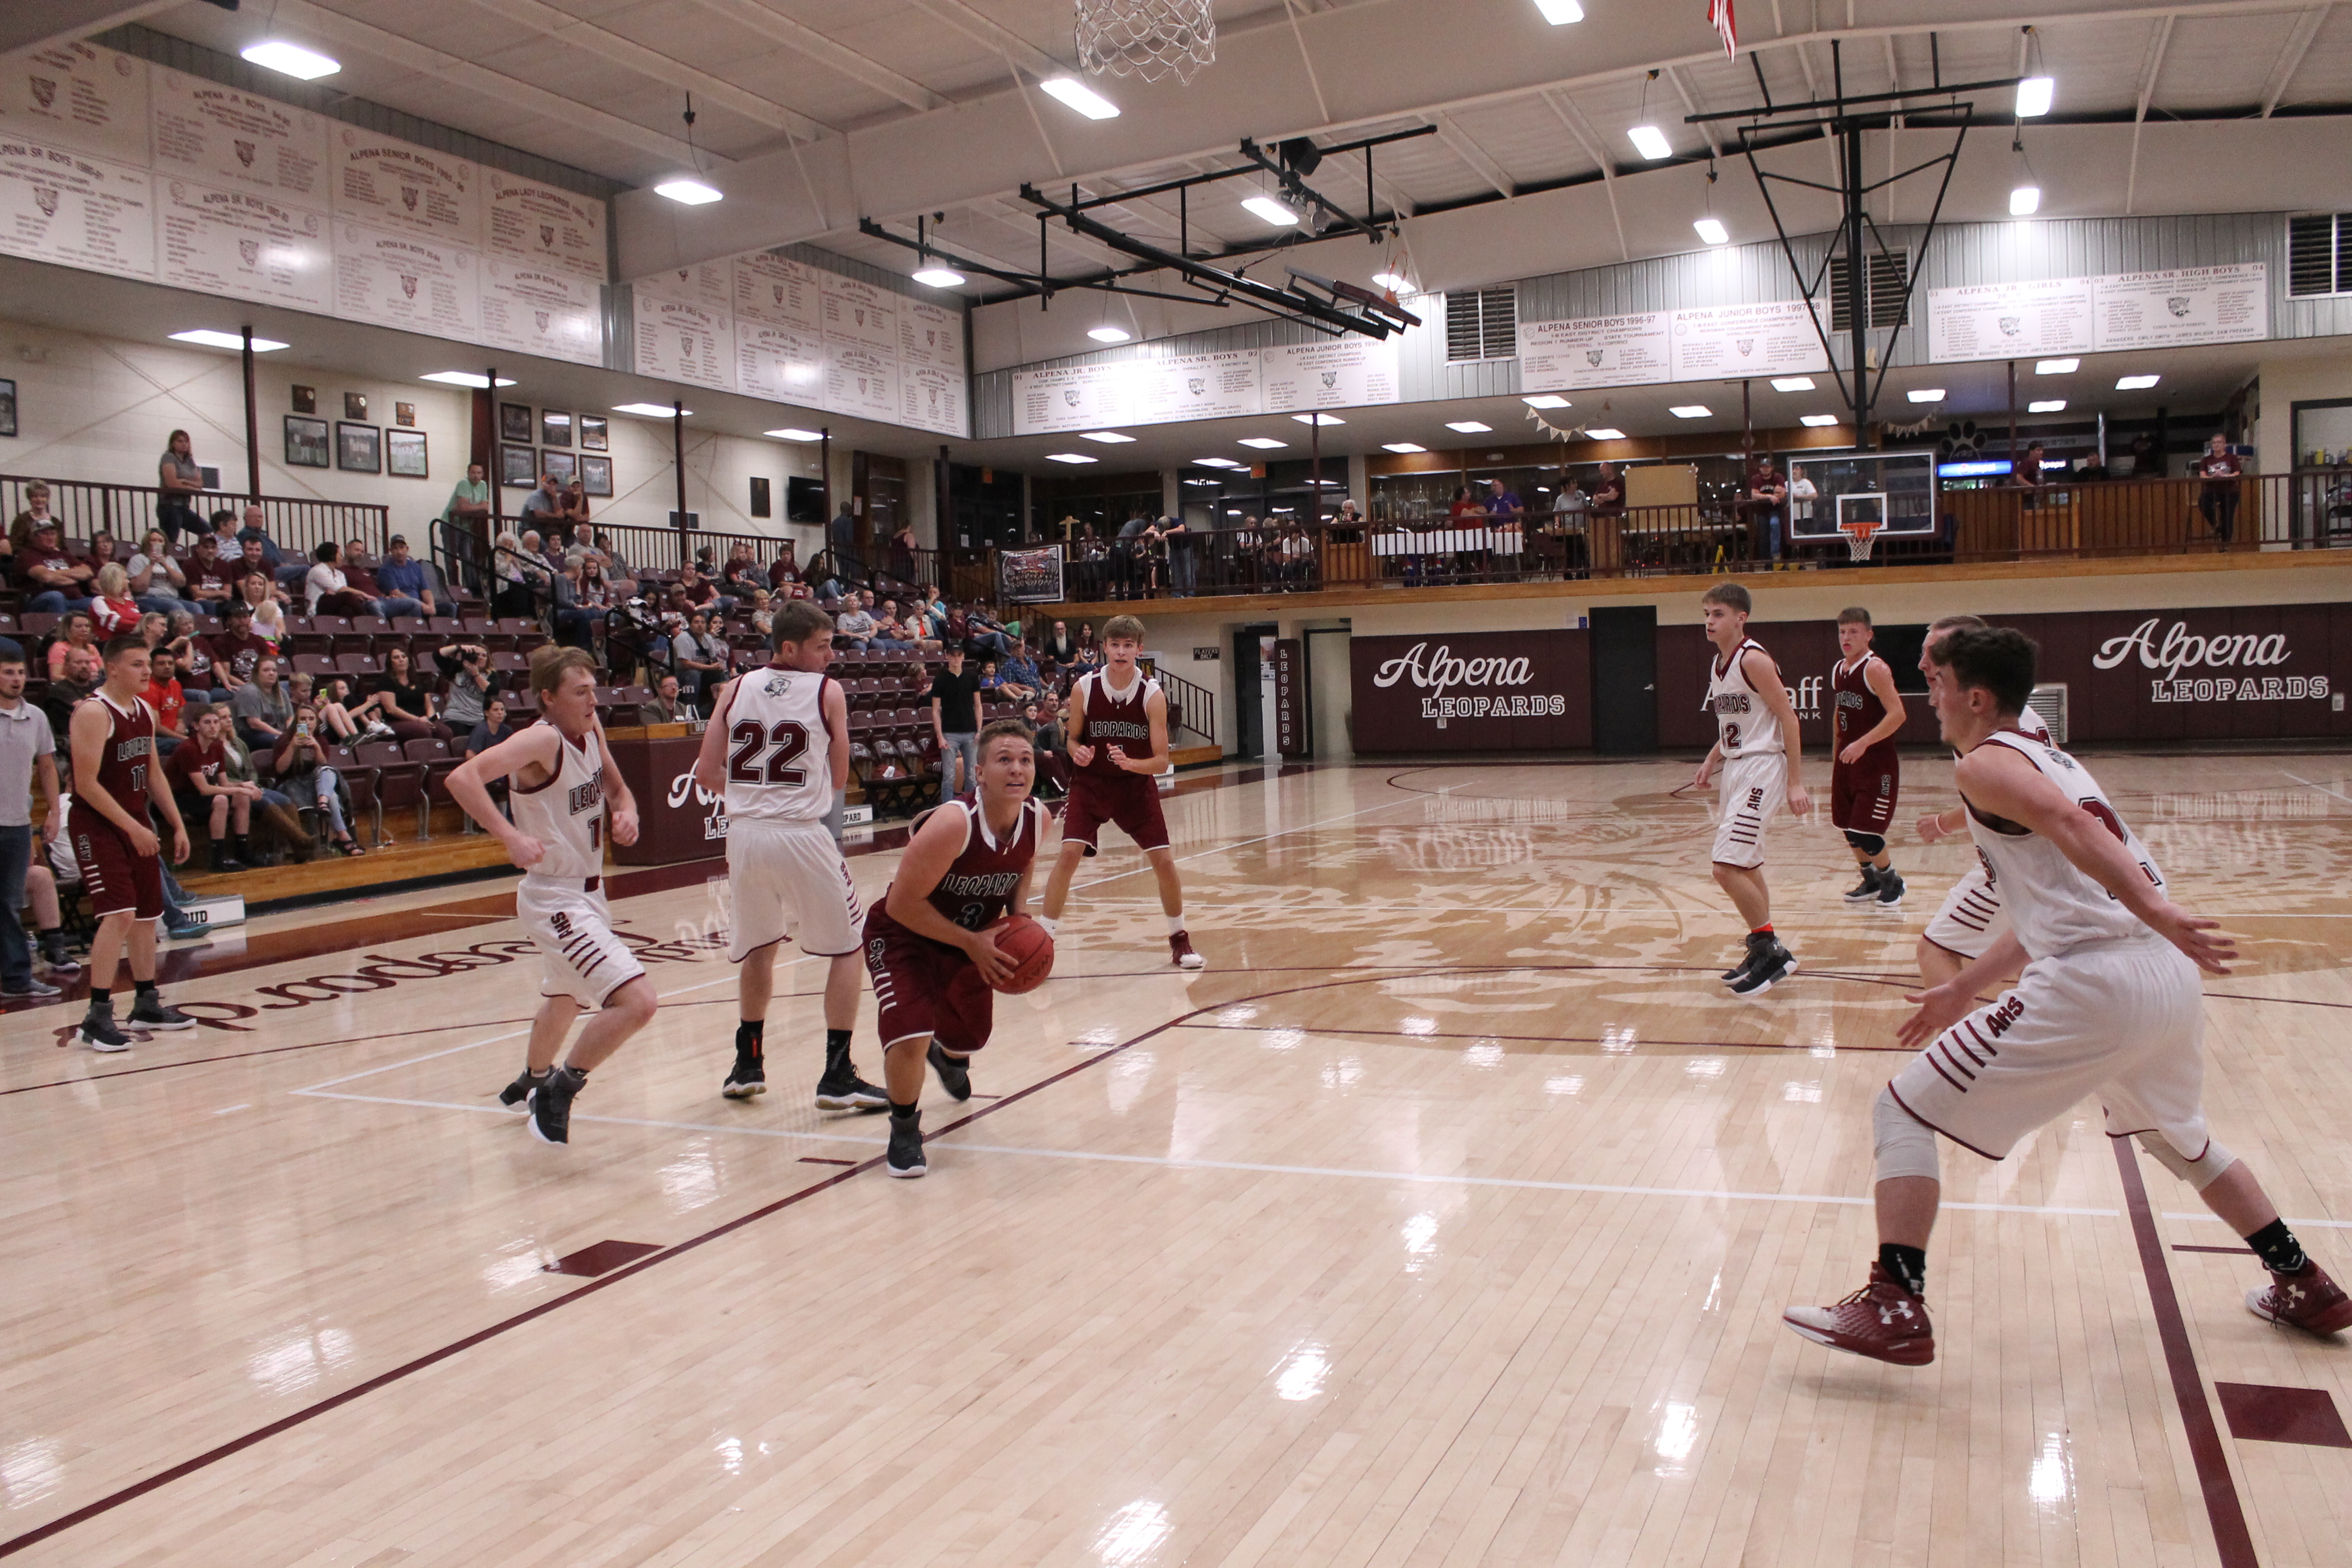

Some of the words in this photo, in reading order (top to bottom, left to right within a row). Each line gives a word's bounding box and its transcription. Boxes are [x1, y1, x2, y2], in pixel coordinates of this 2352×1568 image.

[350, 149, 380, 161] ALPENA
[382, 148, 411, 161] SENIOR
[414, 155, 435, 171] BOYS
[496, 189, 519, 200] ALPENA
[519, 188, 535, 197] LADY
[537, 190, 569, 209] LEOPARDS
[2118, 273, 2159, 283] ALPENA
[2213, 266, 2240, 275] BOYS
[1957, 286, 1999, 296] ALPENA
[2028, 281, 2062, 290] GIRLS
[1676, 312, 1713, 321] ALPENA
[1718, 308, 1752, 318] JUNIOR
[1755, 305, 1782, 315] BOYS
[1787, 303, 1821, 313] 199798
[1538, 323, 1570, 333] ALPENA
[1573, 320, 1602, 330] SENIOR
[1604, 318, 1625, 327] BOYS
[1627, 315, 1656, 325] 1996-97
[1156, 356, 1193, 366] ALPENA
[1213, 352, 1238, 361] BOYS
[1316, 344, 1342, 352] JUNIOR
[1033, 369, 1069, 379] ALPENA
[2092, 618, 2292, 682] Alpena
[1373, 642, 1534, 699] Alpena
[1280, 649, 1289, 745] LEOPARDS
[2152, 676, 2329, 703] LEOPARDS
[1422, 695, 1565, 718] LEOPARDS
[1090, 721, 1148, 739] LEOPARDS
[728, 718, 809, 787] 22
[1881, 775, 1891, 796] AHS
[1746, 786, 1764, 812] AHS
[78, 834, 92, 861] AHS
[551, 912, 574, 940] AHS
[954, 902, 984, 930] 3
[869, 938, 885, 973] AHS
[1986, 996, 2024, 1038] AHS
